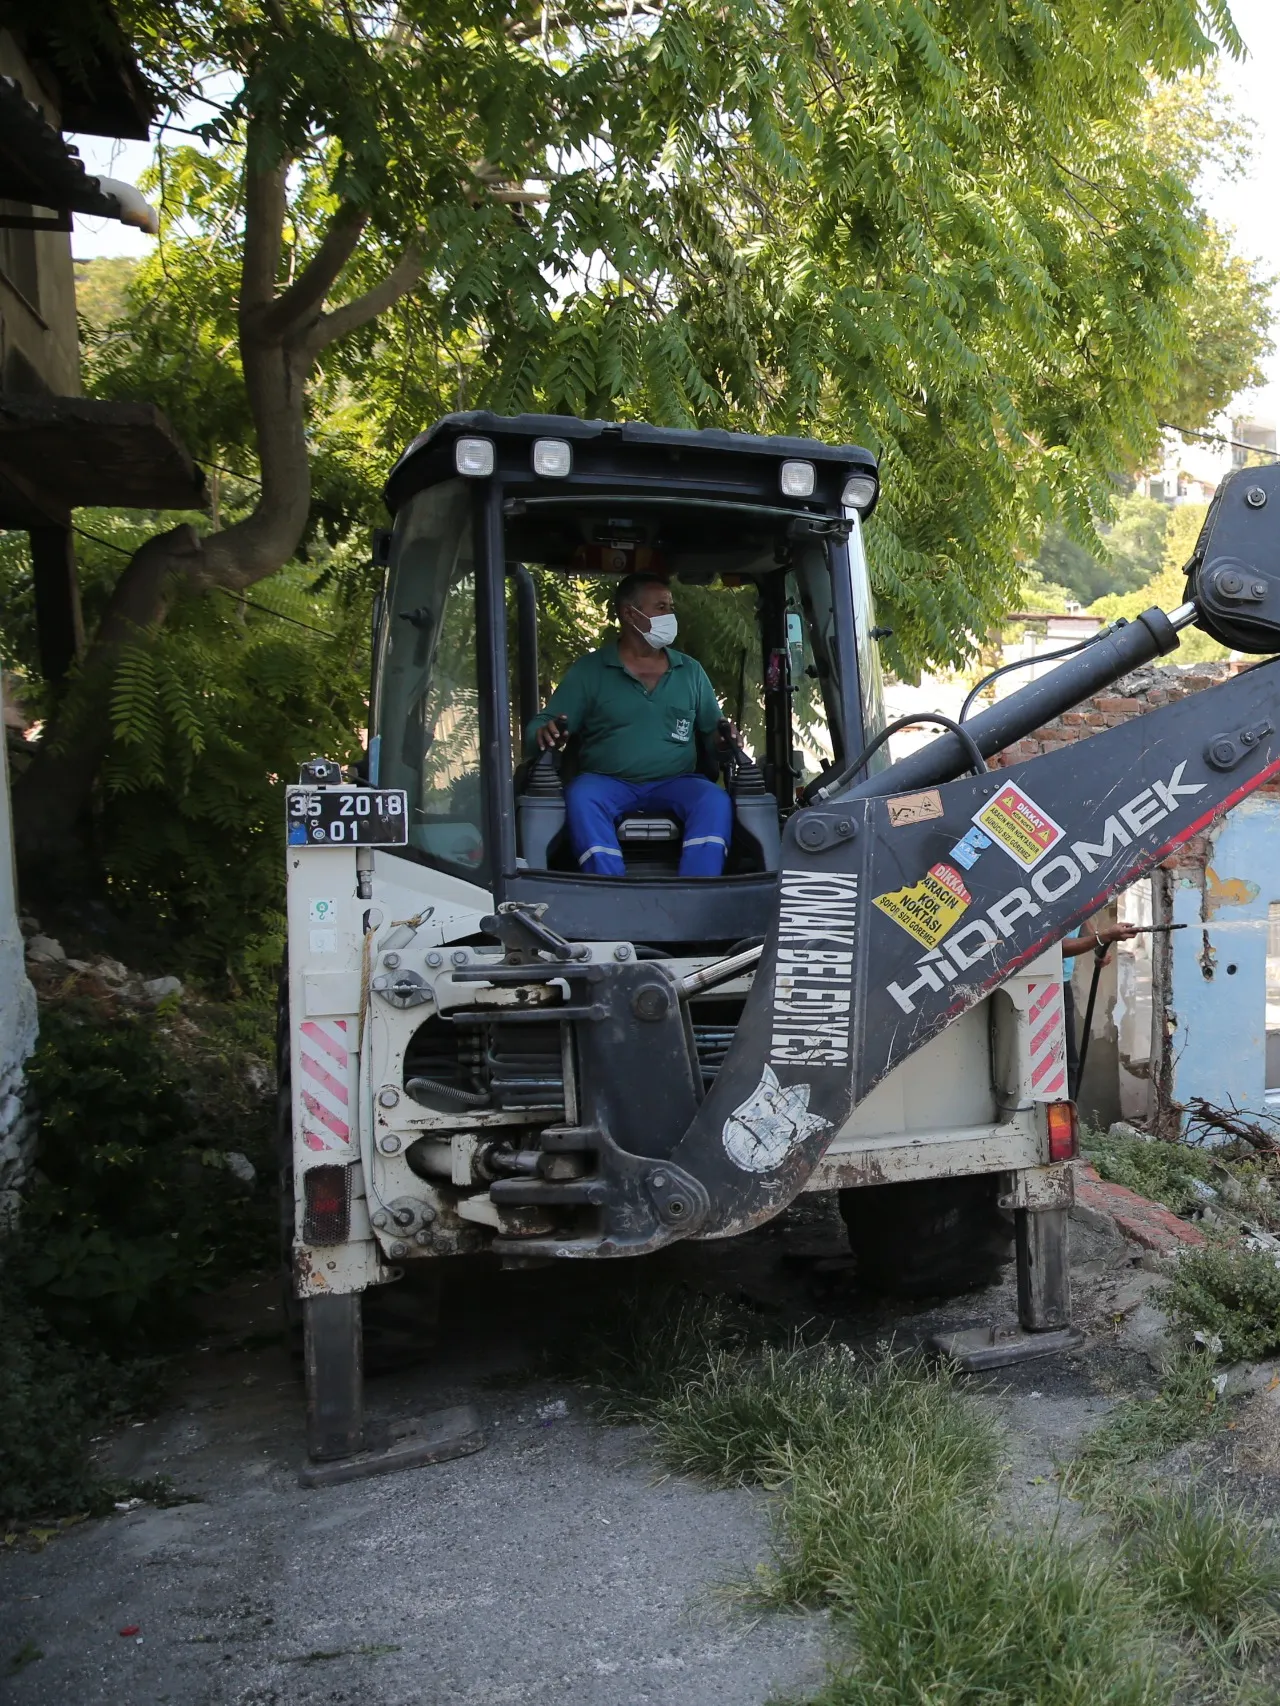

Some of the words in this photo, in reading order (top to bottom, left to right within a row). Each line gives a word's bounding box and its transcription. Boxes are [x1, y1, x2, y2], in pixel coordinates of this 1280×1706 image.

[290, 796, 322, 816] 35
[339, 795, 402, 816] 2018
[1017, 802, 1043, 828] DİKKAT
[330, 820, 358, 841] 01
[778, 869, 858, 945] KONAK
[917, 892, 941, 915] KÖR
[921, 876, 959, 910] ARACIN
[899, 894, 943, 933] NOKTASI
[770, 947, 854, 1068] BELEDİYESİ
